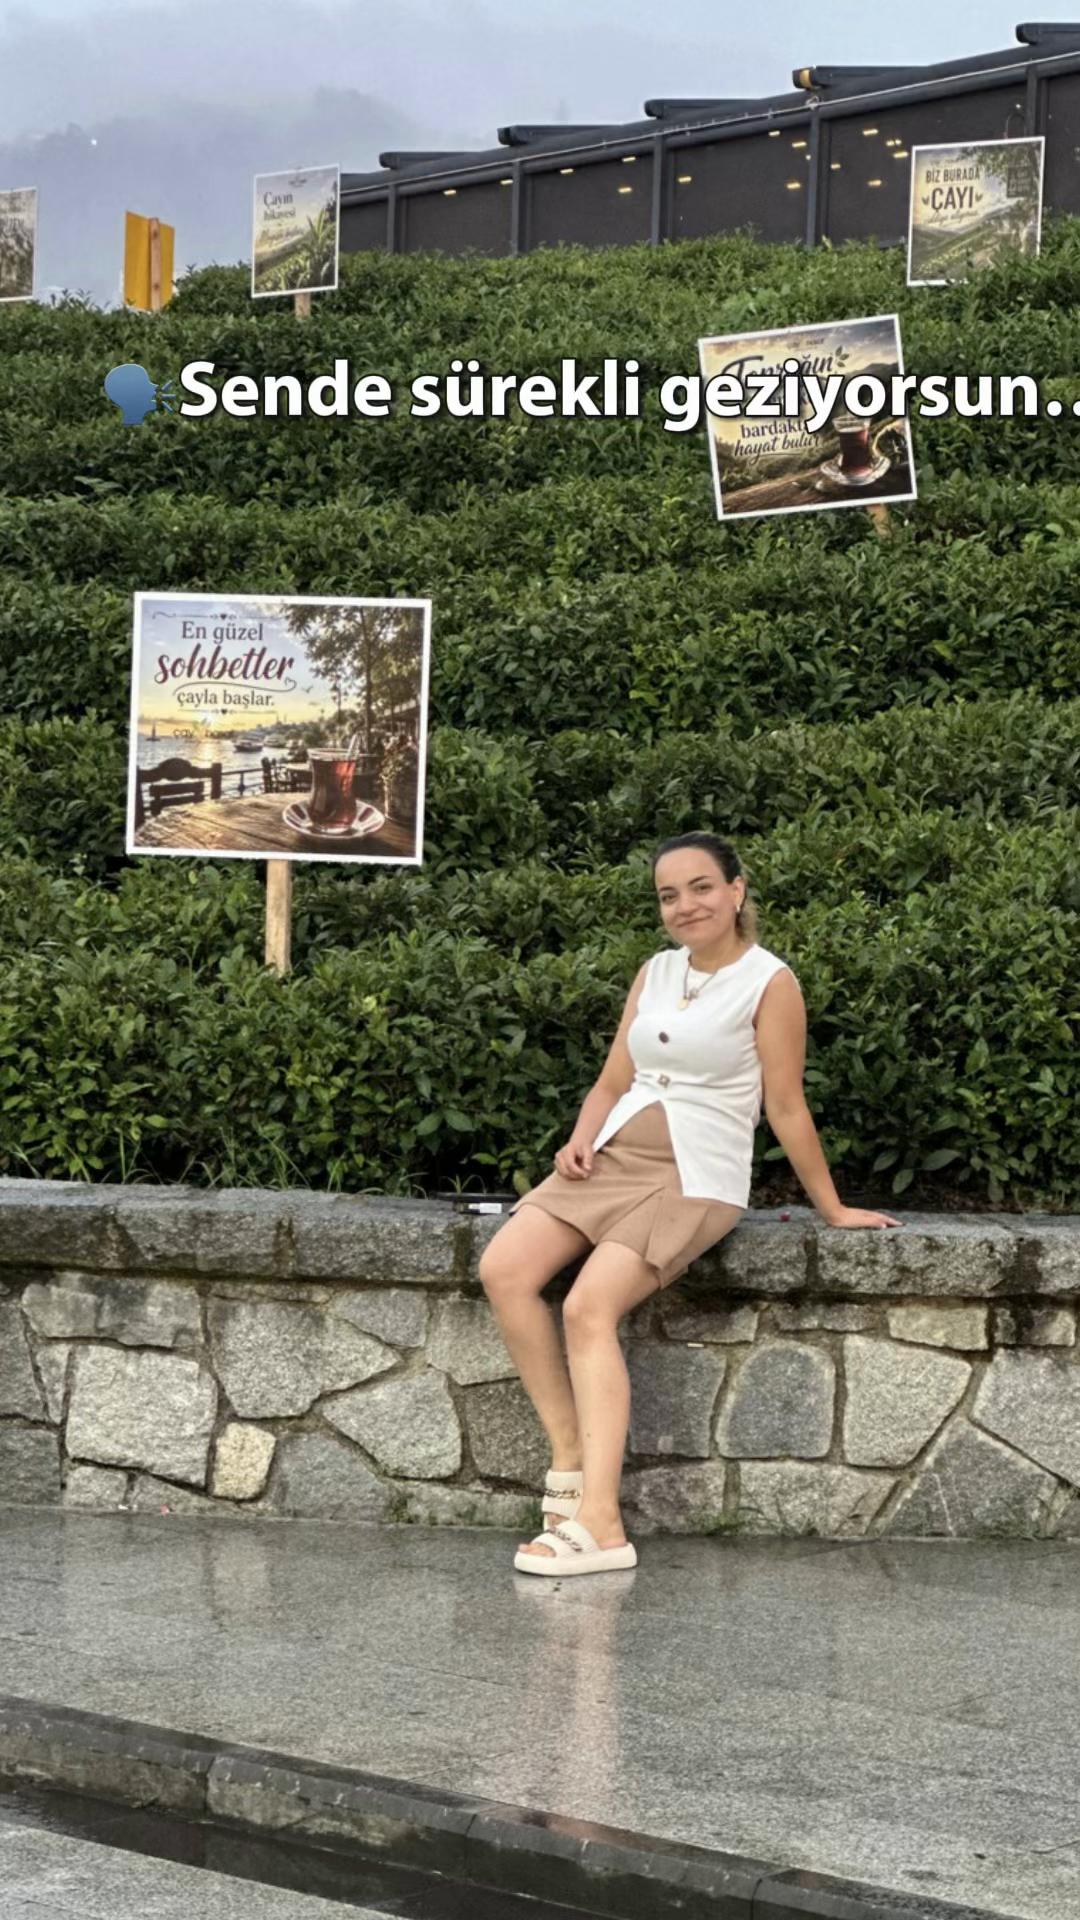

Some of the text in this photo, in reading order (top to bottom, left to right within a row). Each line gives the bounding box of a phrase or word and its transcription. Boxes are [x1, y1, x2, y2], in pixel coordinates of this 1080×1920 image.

[944, 166, 980, 182] BURADA
[931, 186, 974, 213] ÇAYI
[741, 419, 807, 438] bardakt
[734, 432, 820, 465] hayat bulur
[182, 621, 264, 645] En güzel
[154, 642, 295, 685] sohbetler
[177, 688, 275, 709] çayla başlar.
